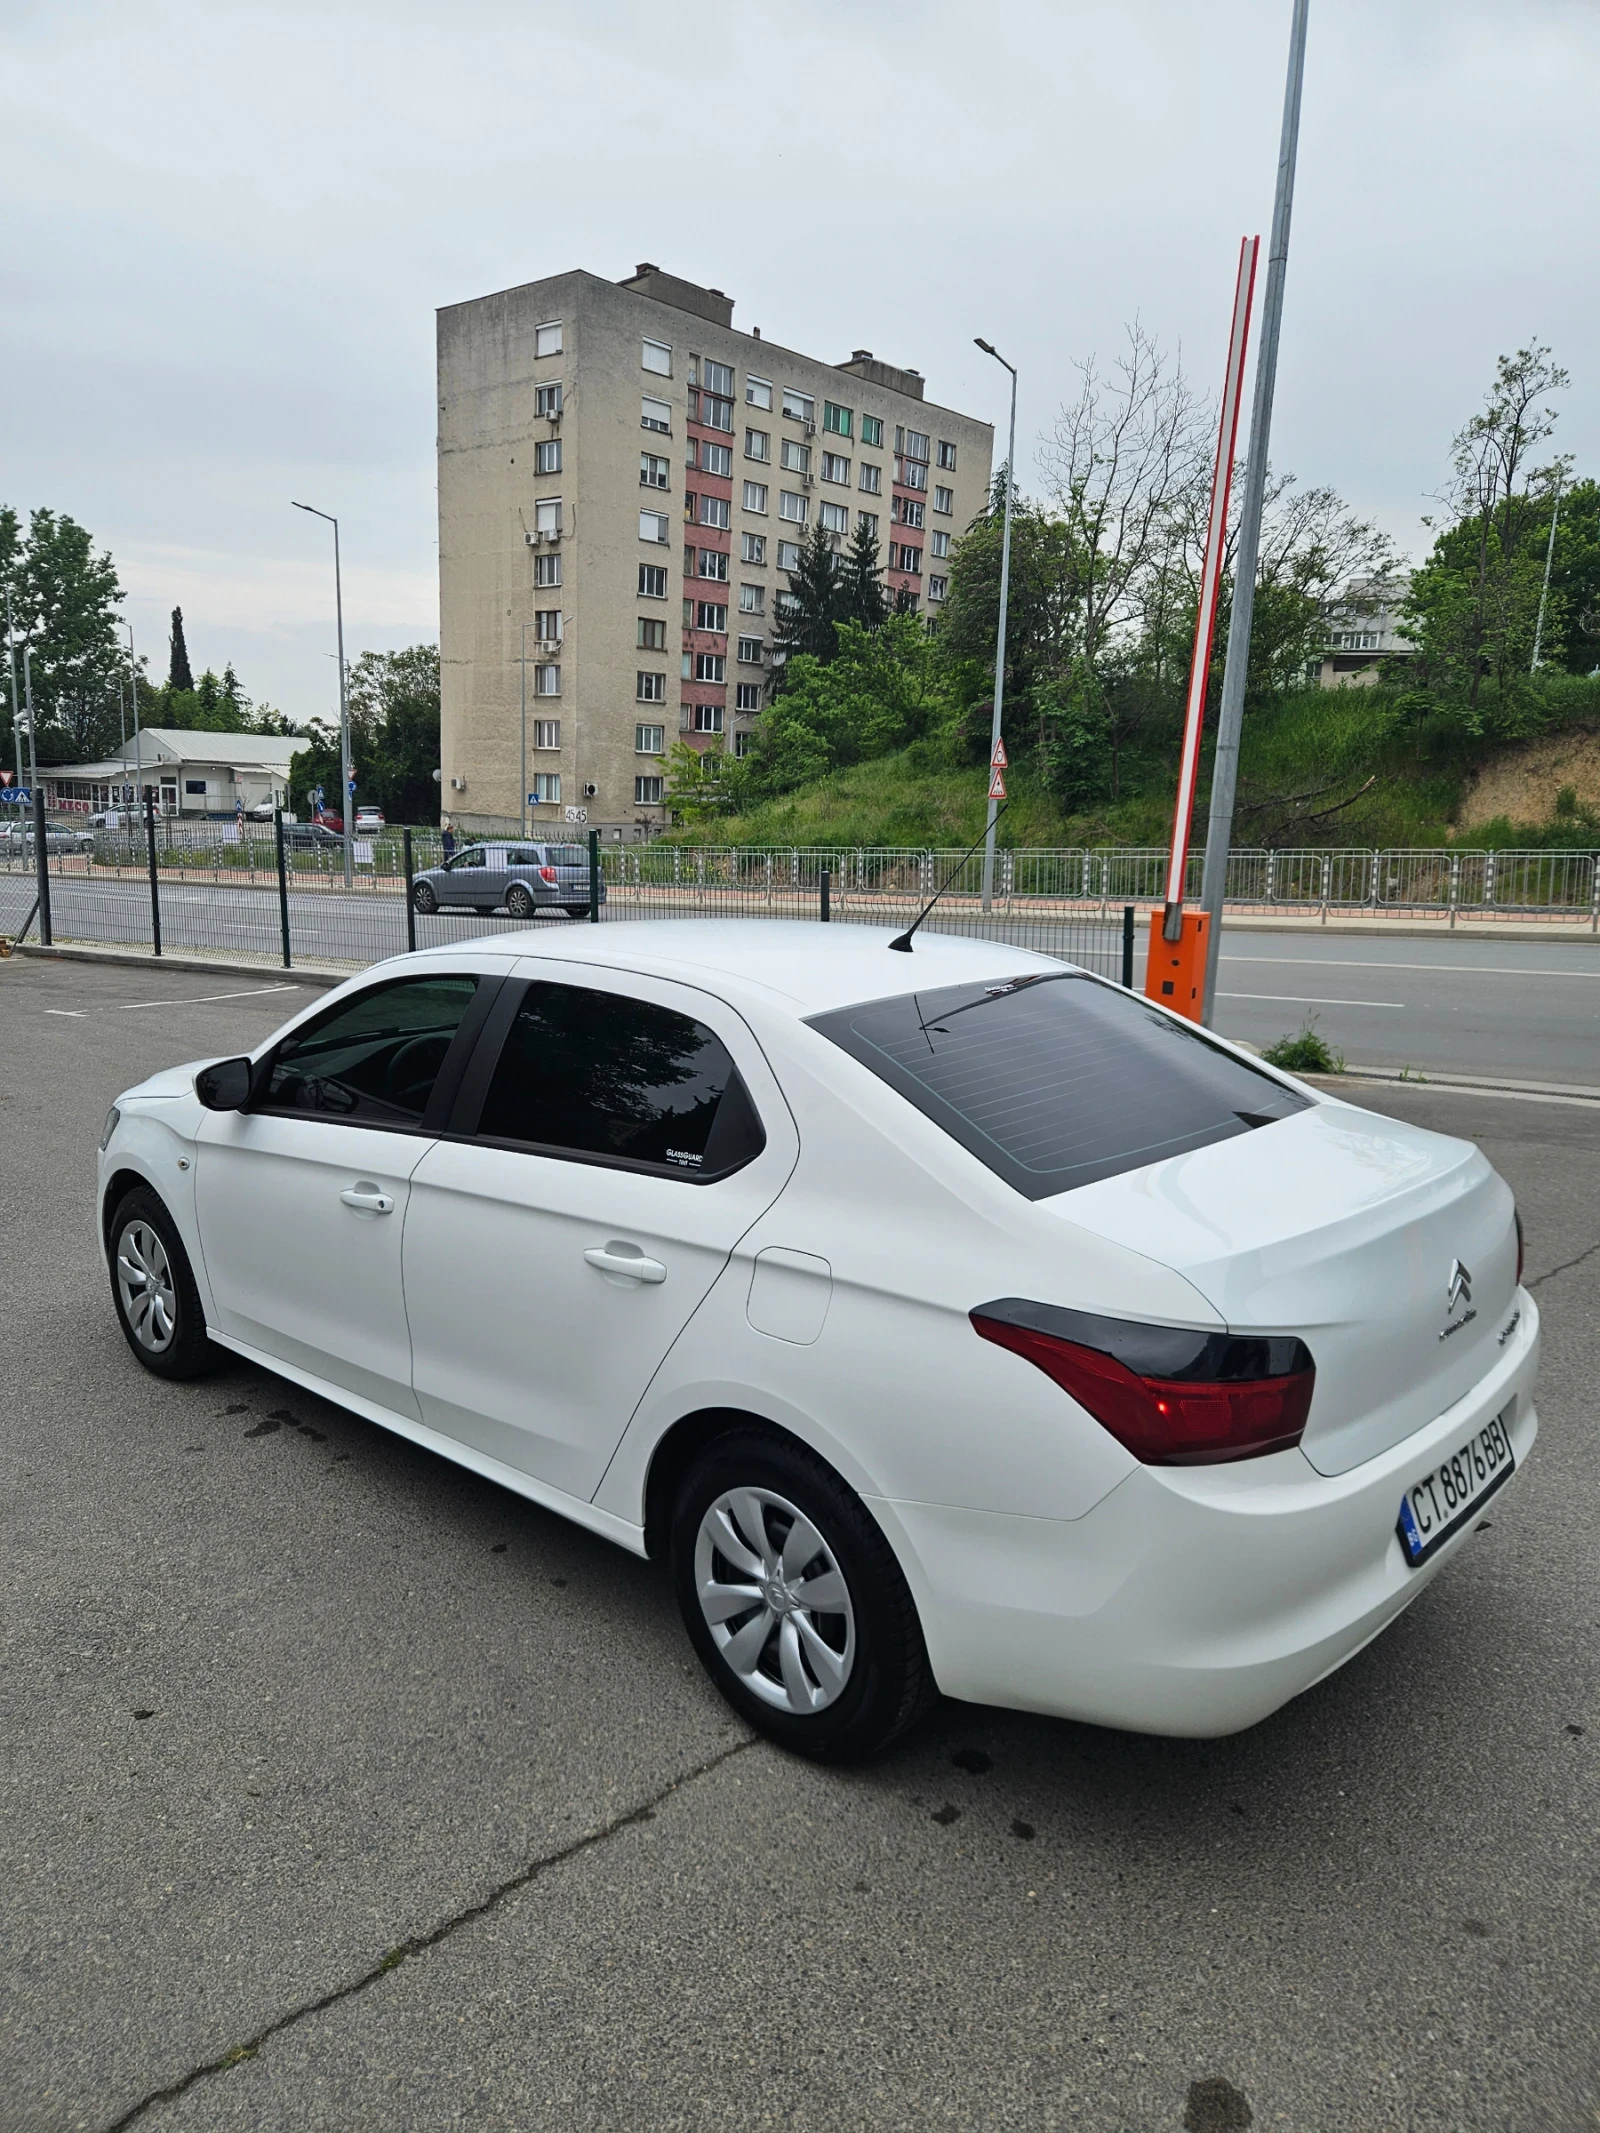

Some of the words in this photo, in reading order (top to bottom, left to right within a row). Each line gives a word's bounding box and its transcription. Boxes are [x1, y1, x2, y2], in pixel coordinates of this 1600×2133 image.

[576, 809, 587, 823] 45
[1440, 1439, 1486, 1510] 8876
[1479, 1420, 1506, 1472] BB
